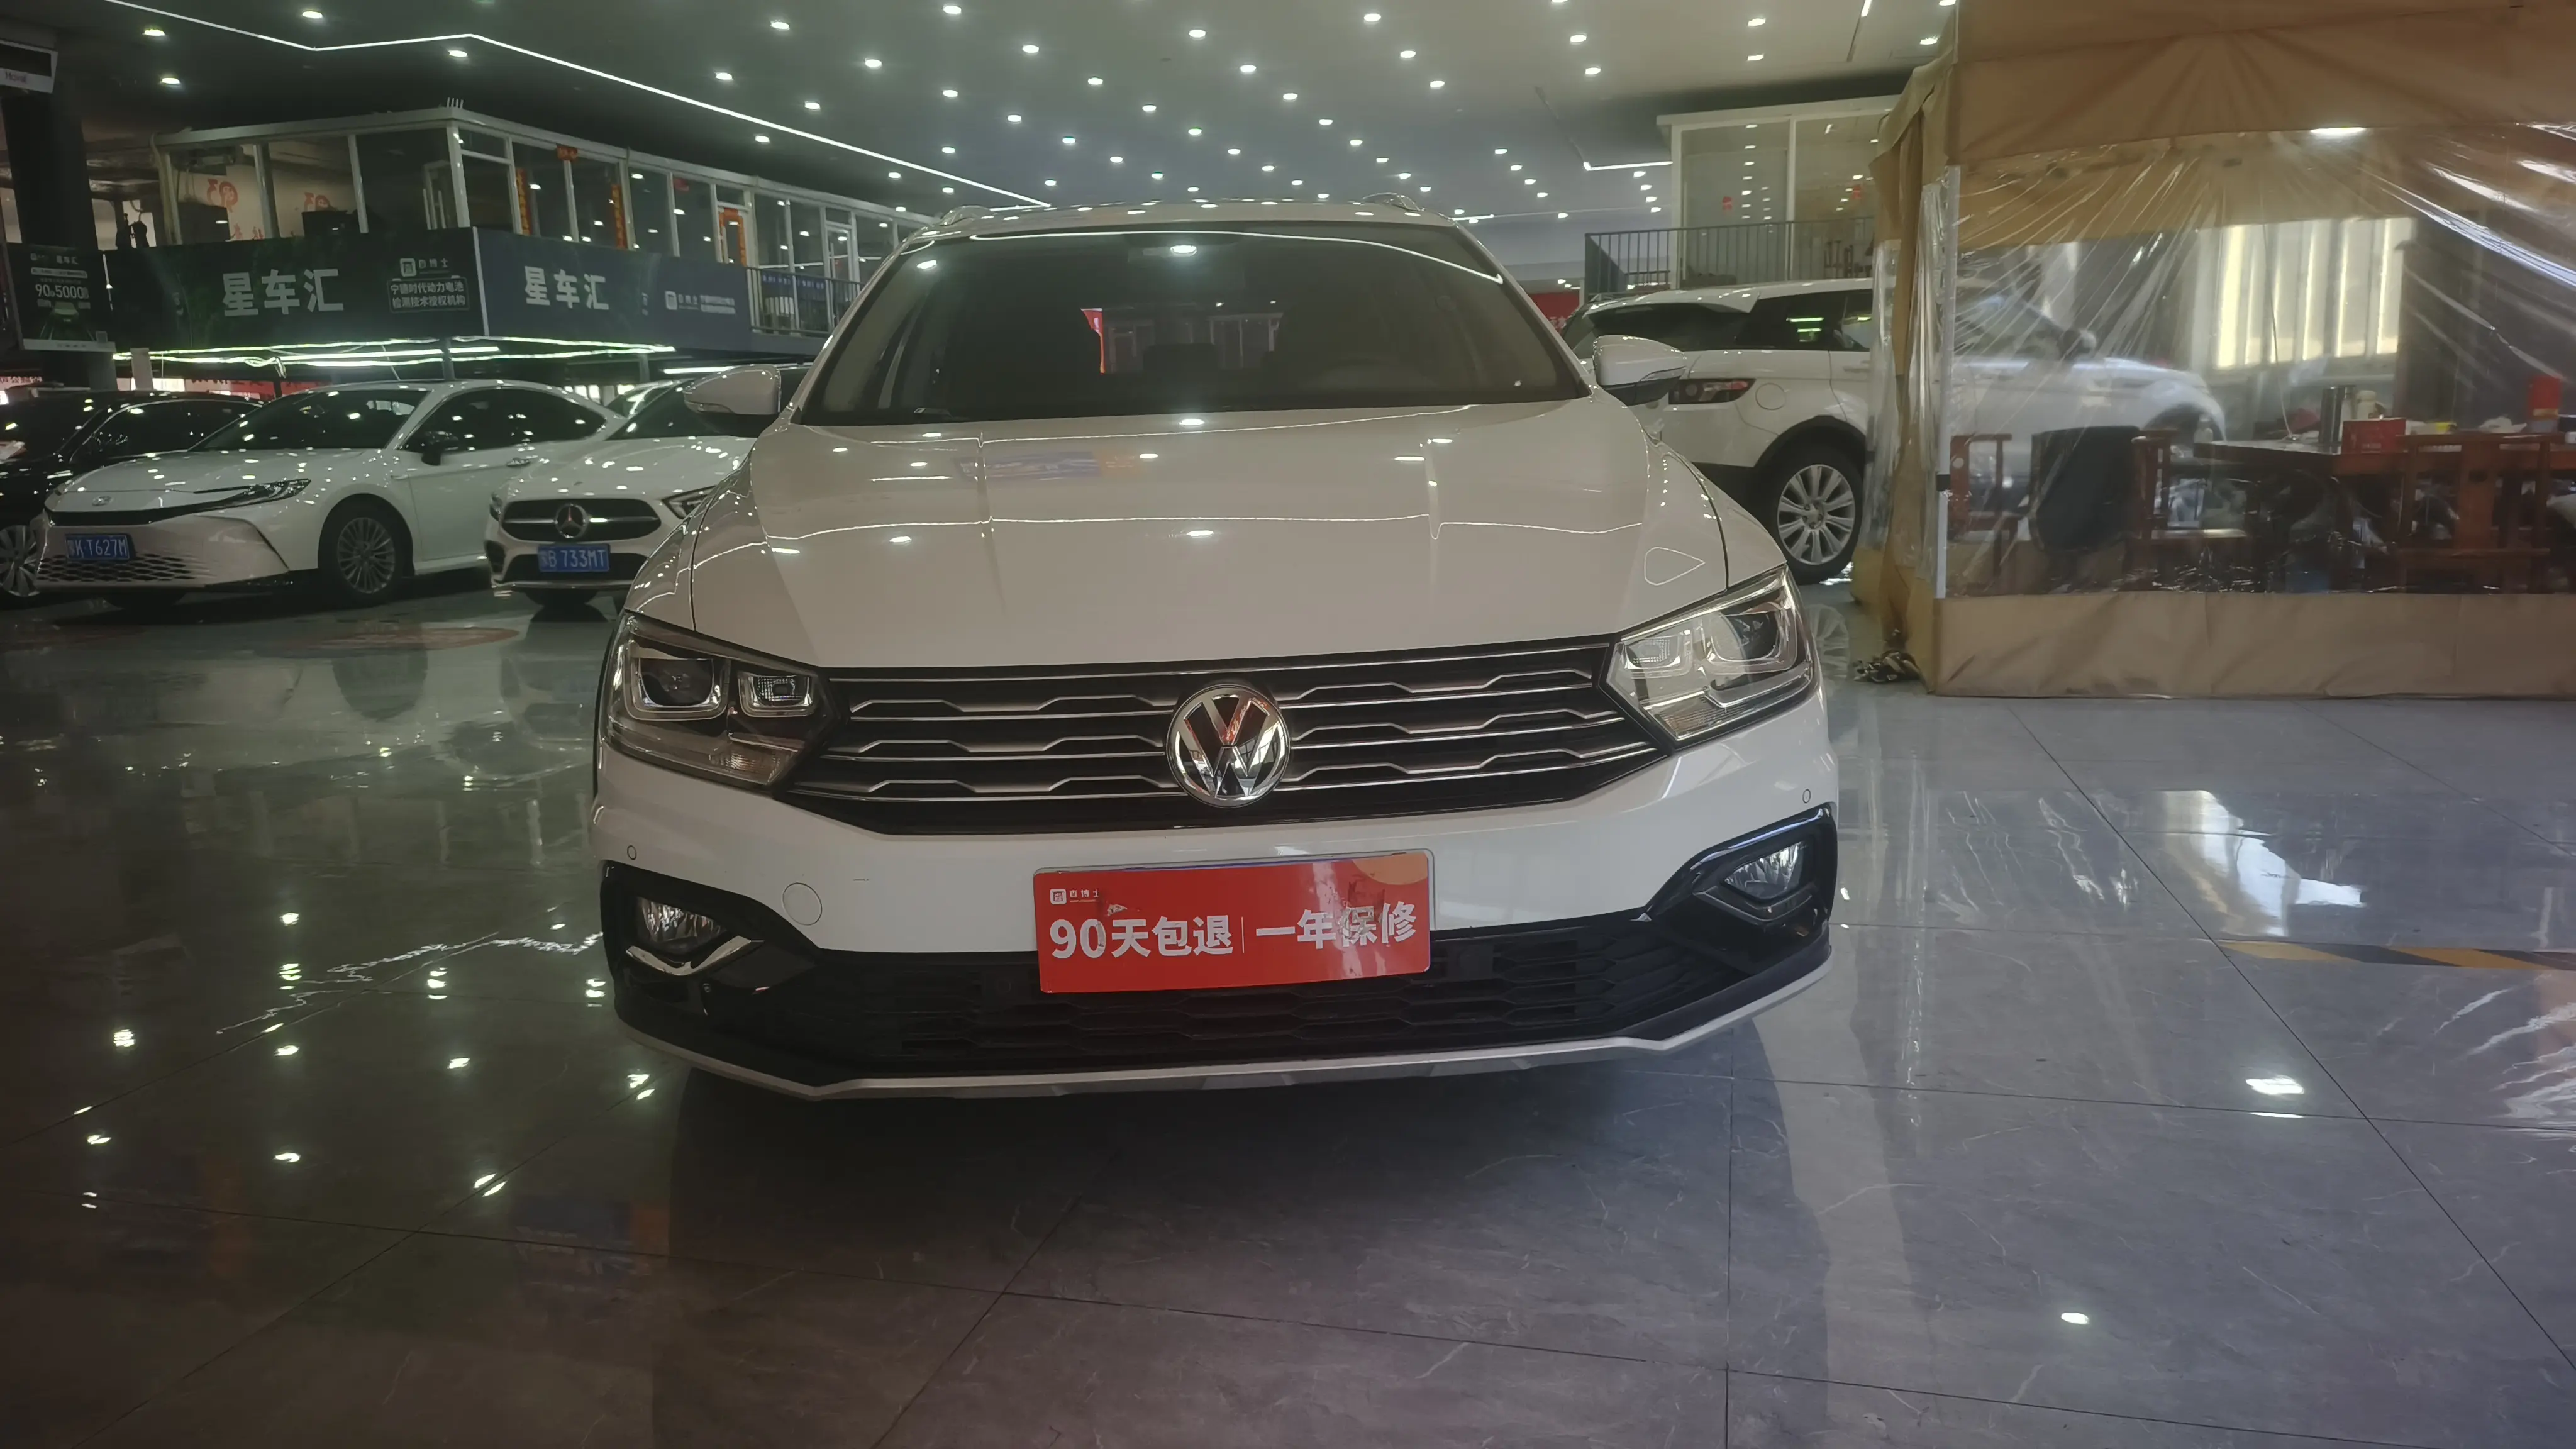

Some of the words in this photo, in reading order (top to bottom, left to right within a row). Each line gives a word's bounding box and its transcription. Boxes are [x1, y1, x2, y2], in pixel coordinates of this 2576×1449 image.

[222, 269, 345, 317] 星车汇
[525, 265, 609, 311] 星车汇
[1049, 915, 1233, 959] 90天包退
[1255, 901, 1418, 949] 一年保修
